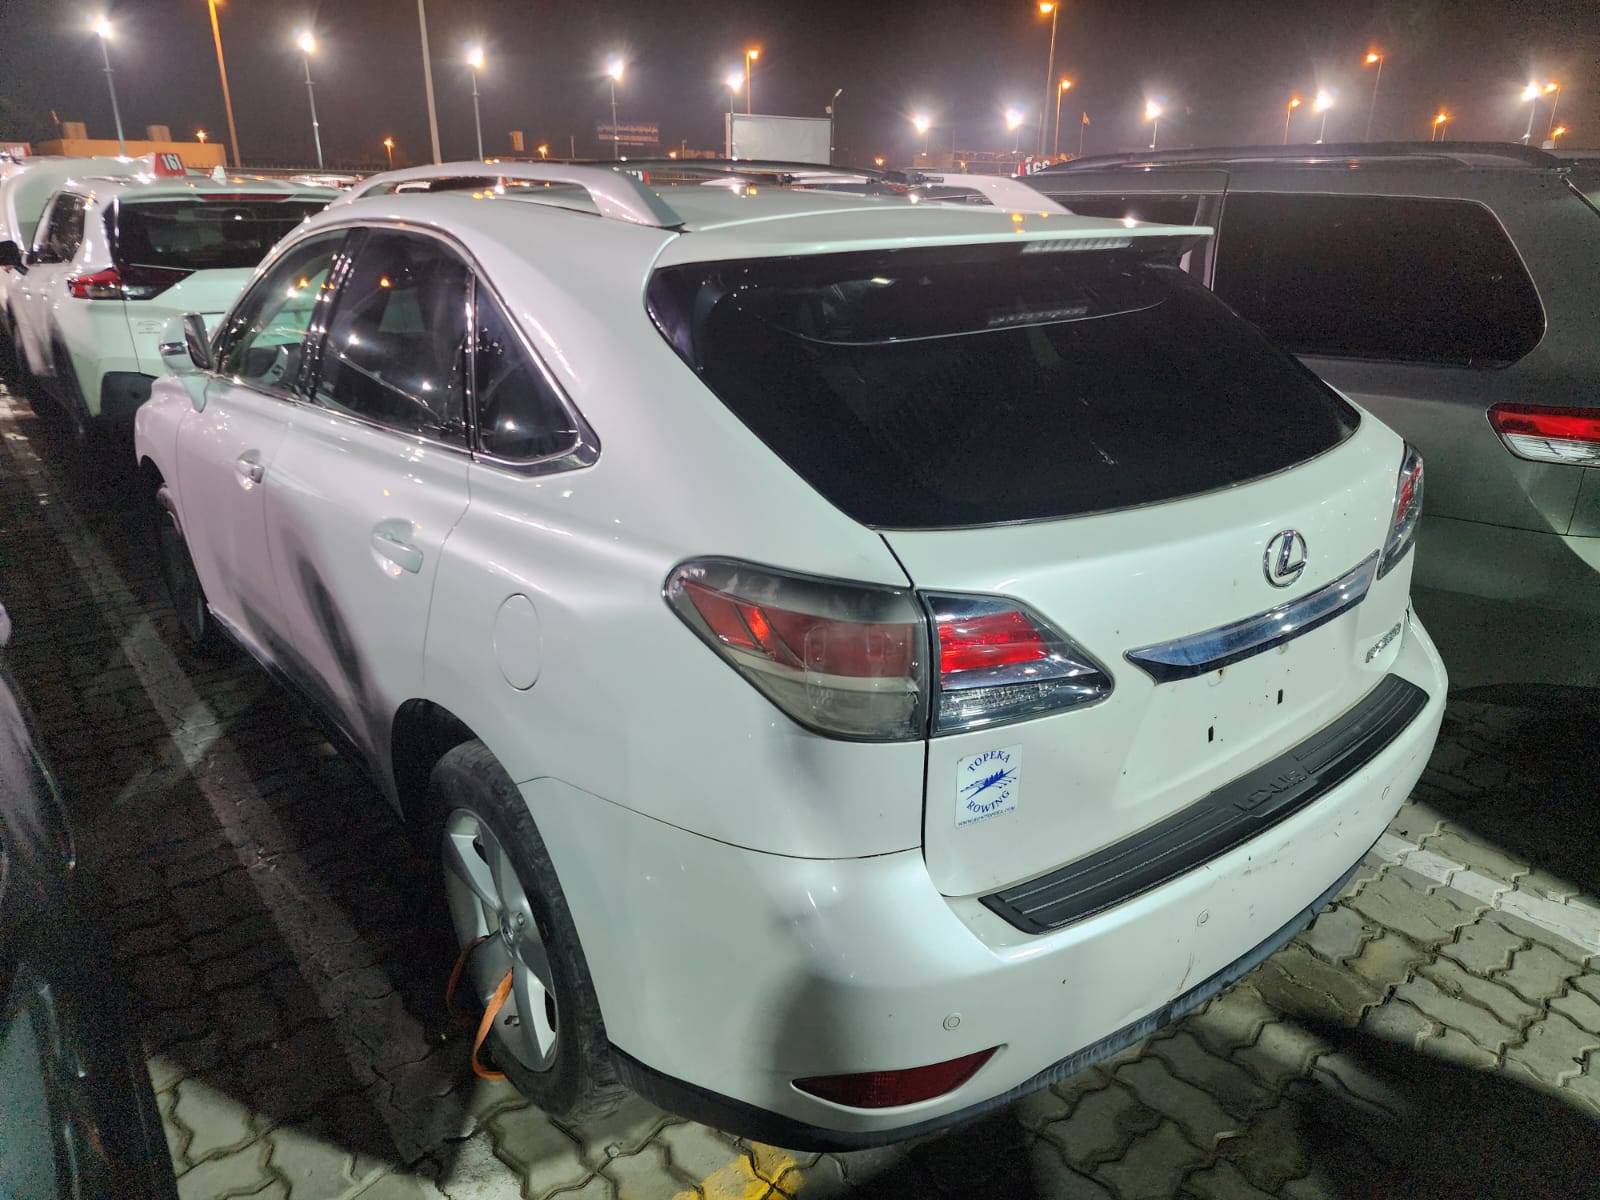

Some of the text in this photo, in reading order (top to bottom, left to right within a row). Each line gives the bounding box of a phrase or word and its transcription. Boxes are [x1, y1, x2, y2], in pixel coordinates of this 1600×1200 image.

[161, 153, 184, 170] 161
[967, 750, 1010, 772] TOPEKA
[966, 790, 1010, 813] ROWING
